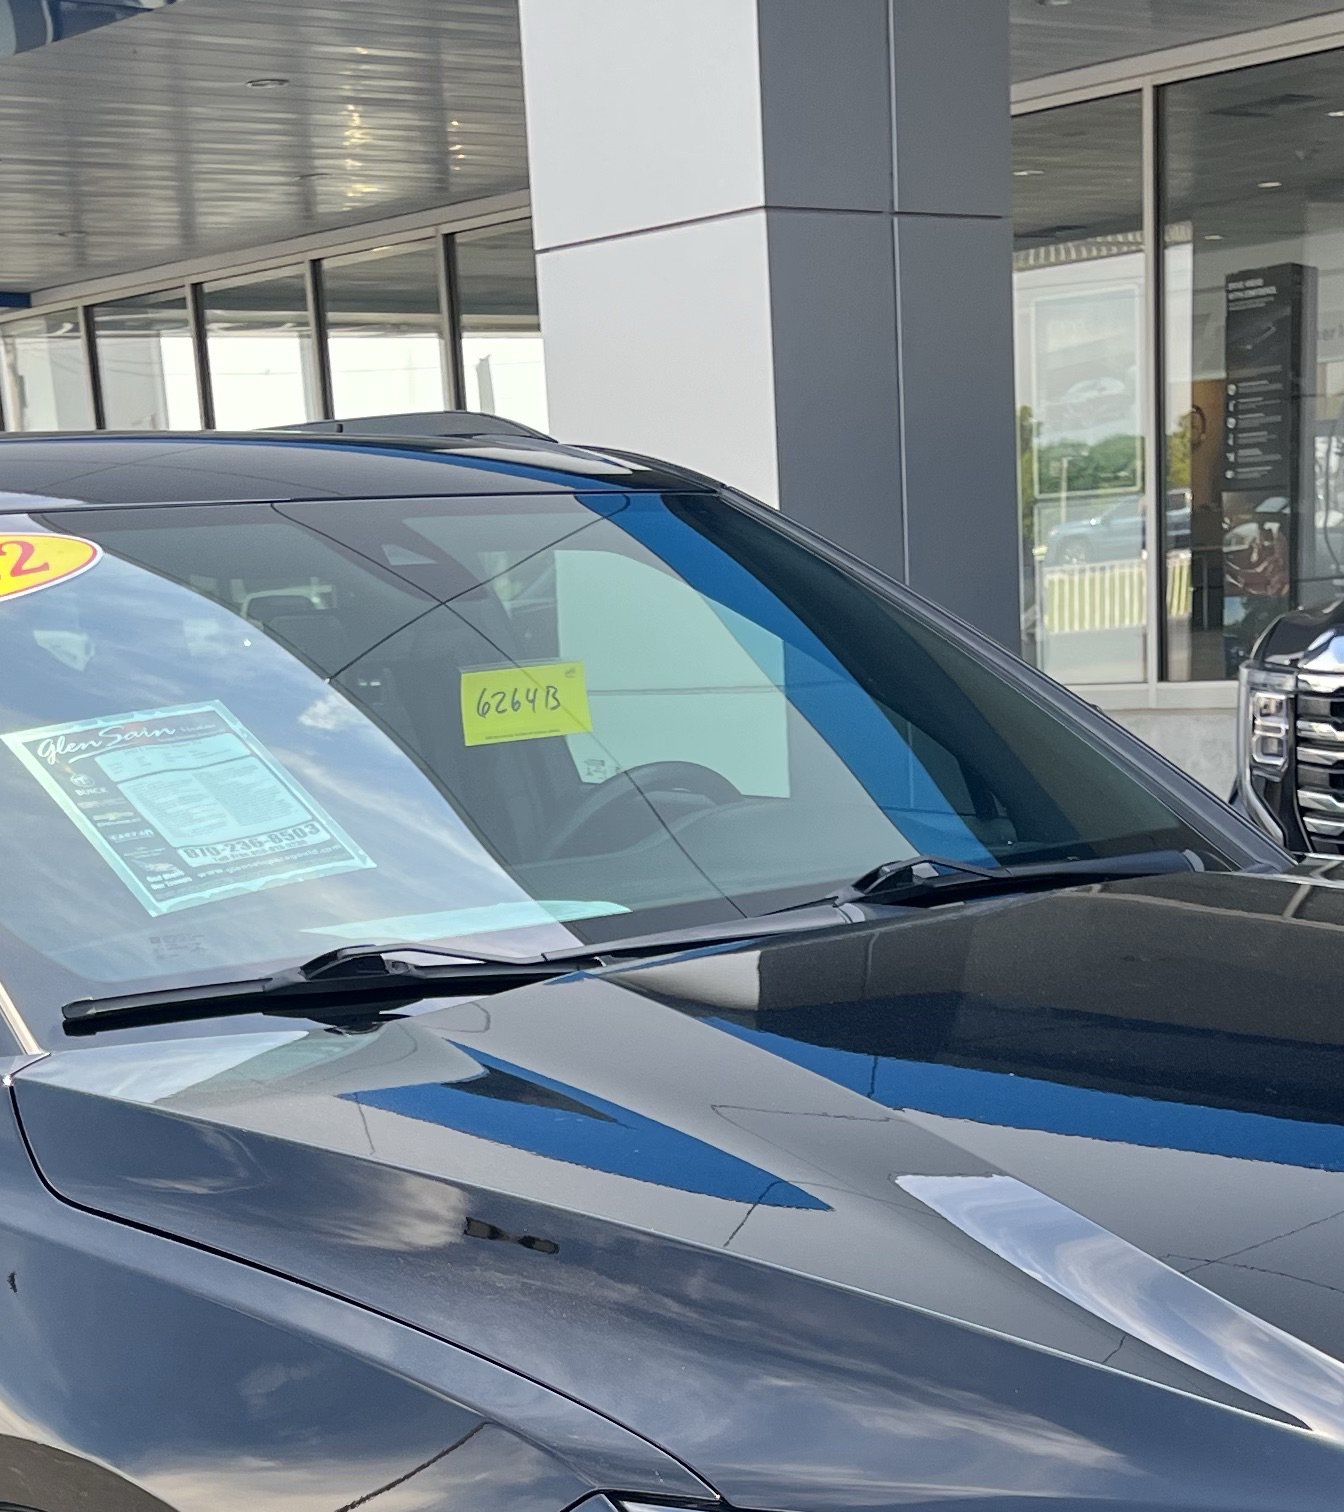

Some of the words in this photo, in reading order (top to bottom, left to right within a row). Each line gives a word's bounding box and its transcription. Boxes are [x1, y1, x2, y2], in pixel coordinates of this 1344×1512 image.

[476, 685, 561, 718] 6264B
[37, 735, 102, 765] Glen
[98, 725, 176, 749] Sain
